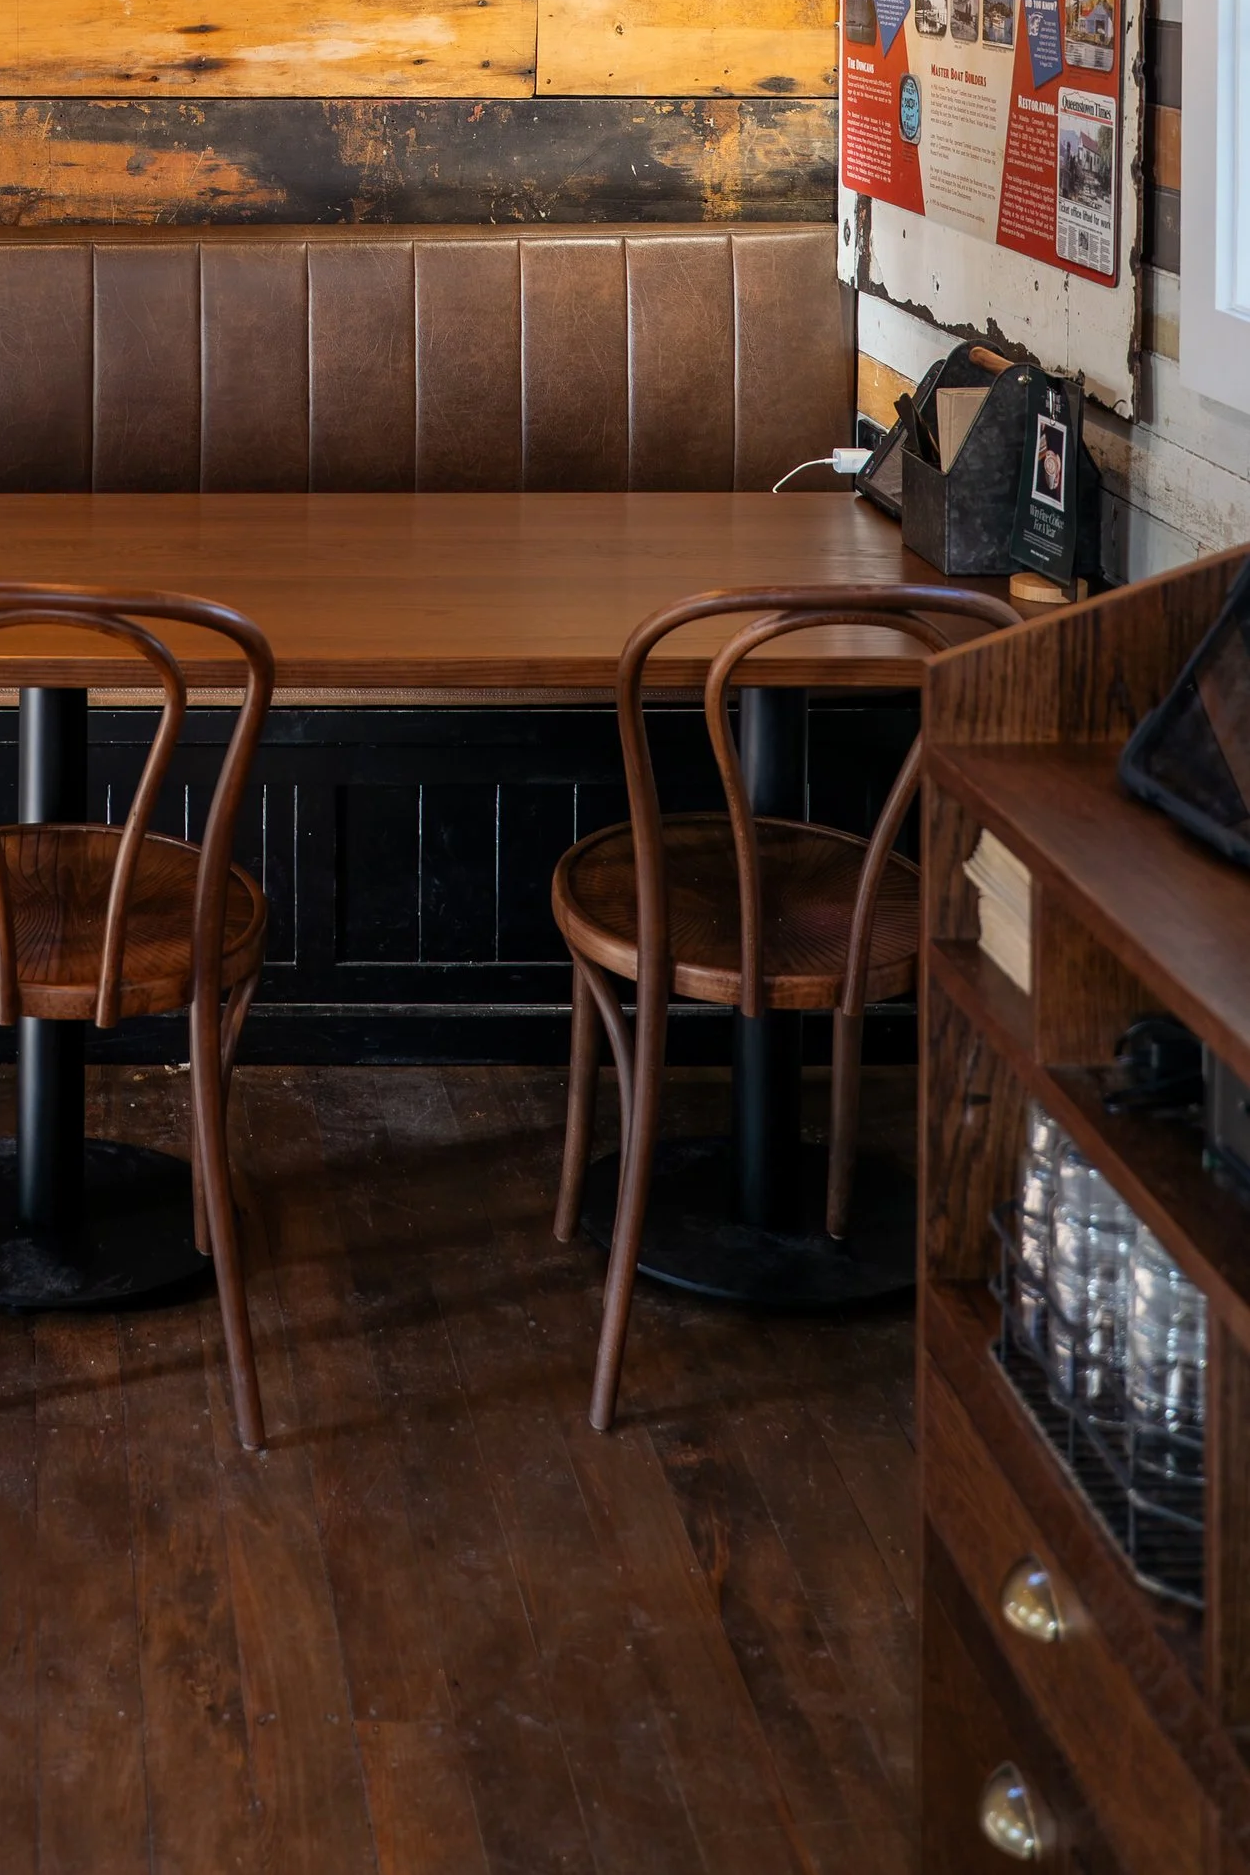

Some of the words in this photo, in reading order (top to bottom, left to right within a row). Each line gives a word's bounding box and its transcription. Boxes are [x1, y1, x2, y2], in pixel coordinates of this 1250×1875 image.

[930, 63, 949, 79] MASTER
[950, 67, 963, 82] BOAT
[964, 71, 986, 87] BUILDERS
[1018, 94, 1055, 116] RESTORATION
[1062, 94, 1094, 115] Queenstown
[1094, 102, 1112, 120] Times
